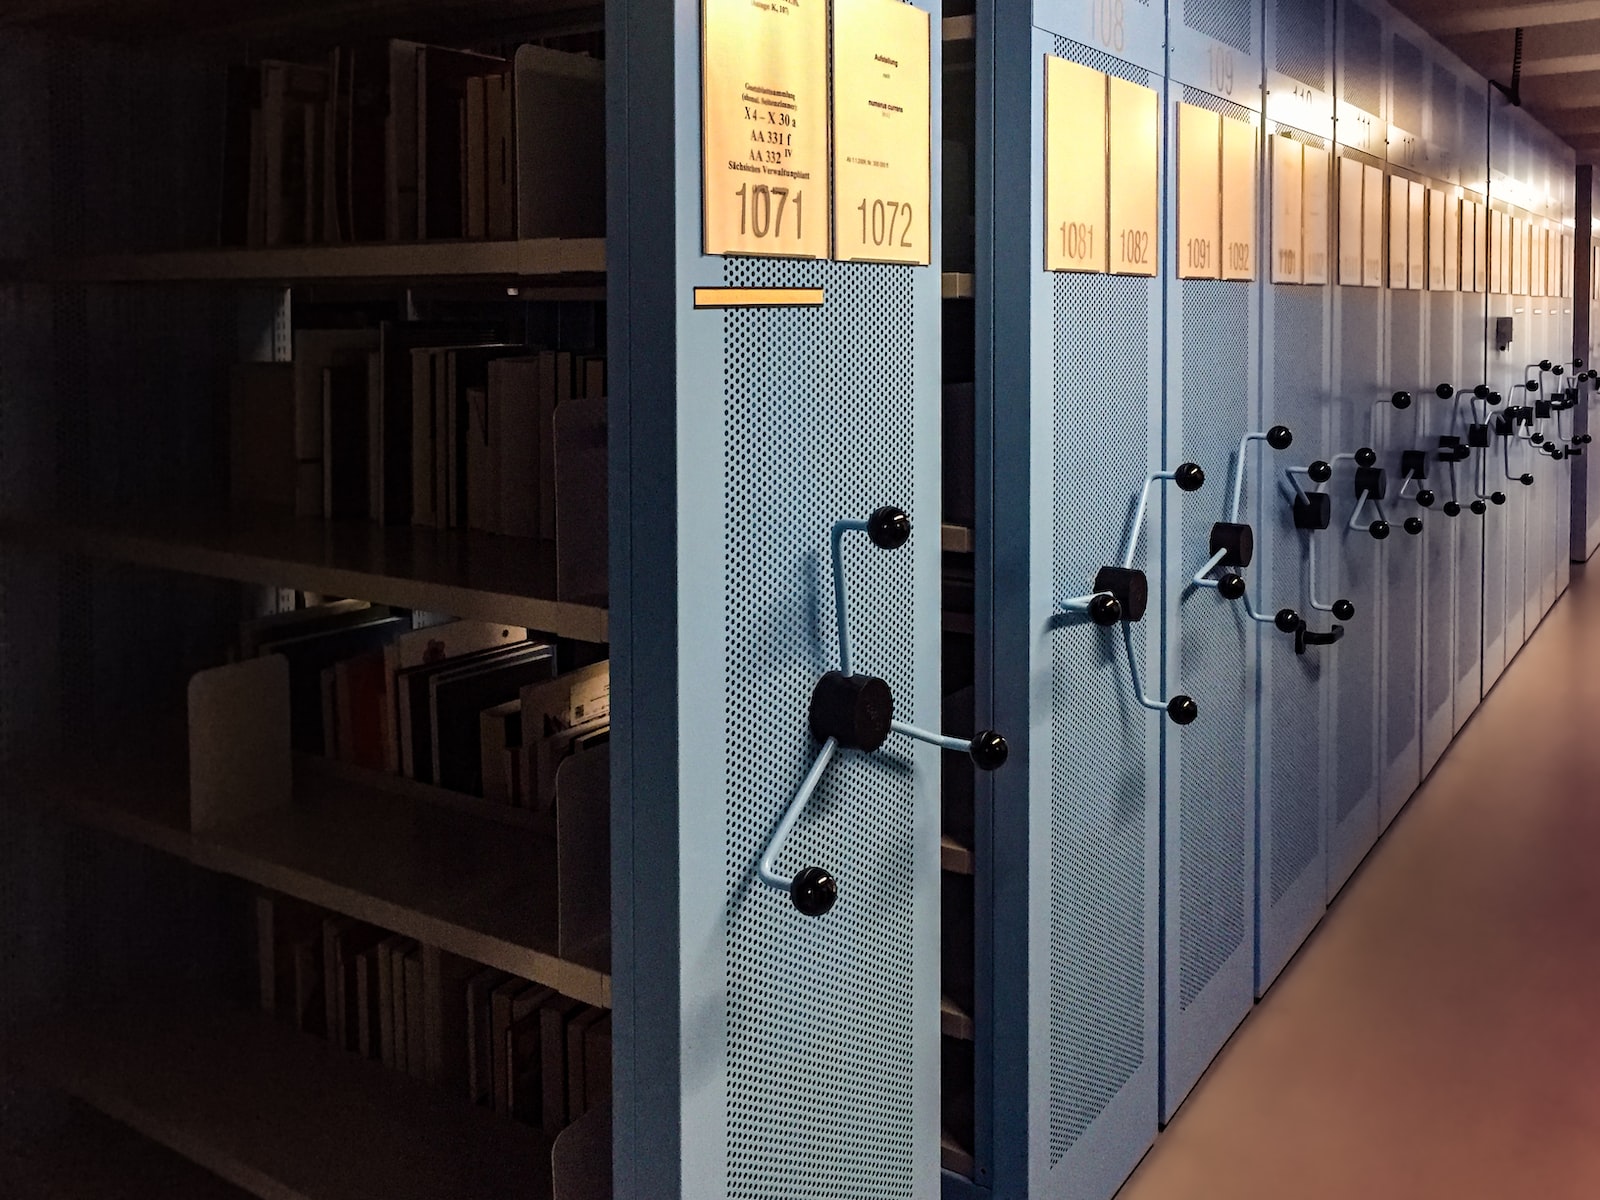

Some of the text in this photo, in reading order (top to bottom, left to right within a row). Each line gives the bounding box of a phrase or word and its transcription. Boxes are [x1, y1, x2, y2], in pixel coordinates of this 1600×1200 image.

[1091, 0, 1124, 51] 108
[1208, 43, 1234, 96] 109
[767, 111, 776, 125] X
[778, 112, 790, 127] 30
[791, 118, 797, 128] a
[750, 129, 792, 146] AA 331 f
[749, 148, 793, 165] AA 332 IV
[735, 182, 802, 240] 1071
[857, 198, 912, 248] 1072
[1060, 221, 1094, 260] 1081
[1120, 229, 1149, 264] 1082
[1187, 238, 1211, 269] 1091
[1228, 242, 1249, 271] 1092
